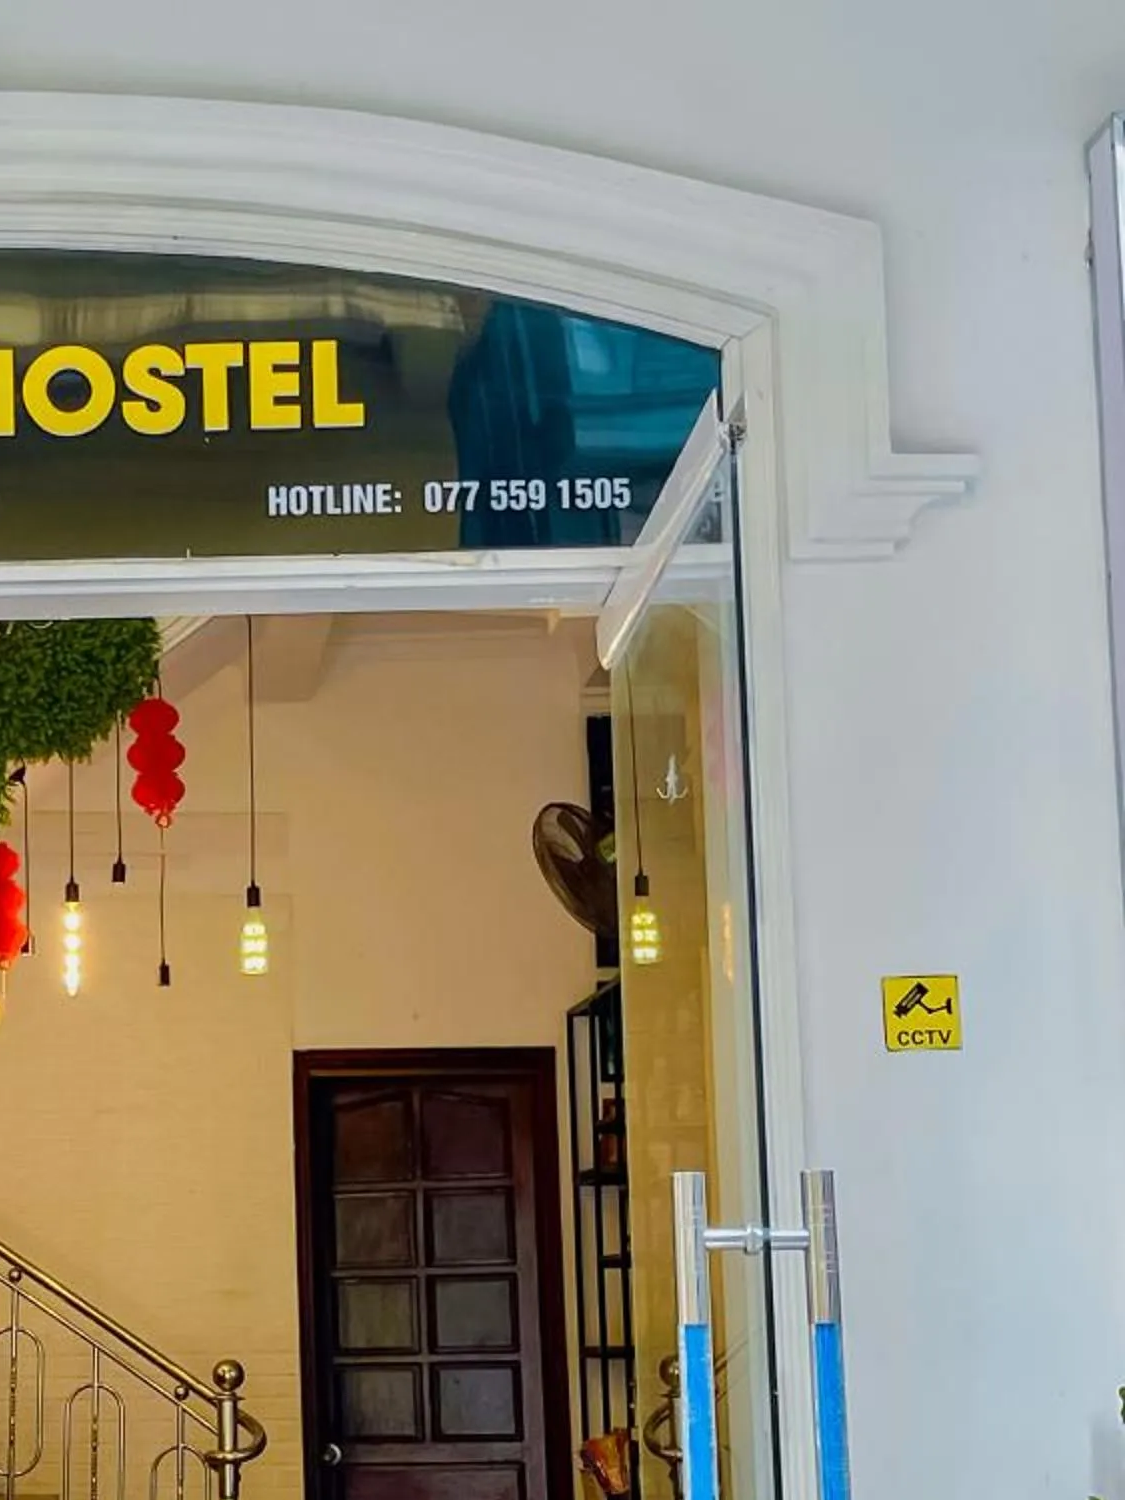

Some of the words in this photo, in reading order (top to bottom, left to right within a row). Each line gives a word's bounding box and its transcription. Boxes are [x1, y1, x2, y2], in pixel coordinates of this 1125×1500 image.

[267, 483, 403, 517] HOTLINE:
[423, 481, 480, 513] 077
[489, 479, 546, 511] 559
[557, 478, 631, 509] 1505
[897, 1030, 951, 1046] CCTV
